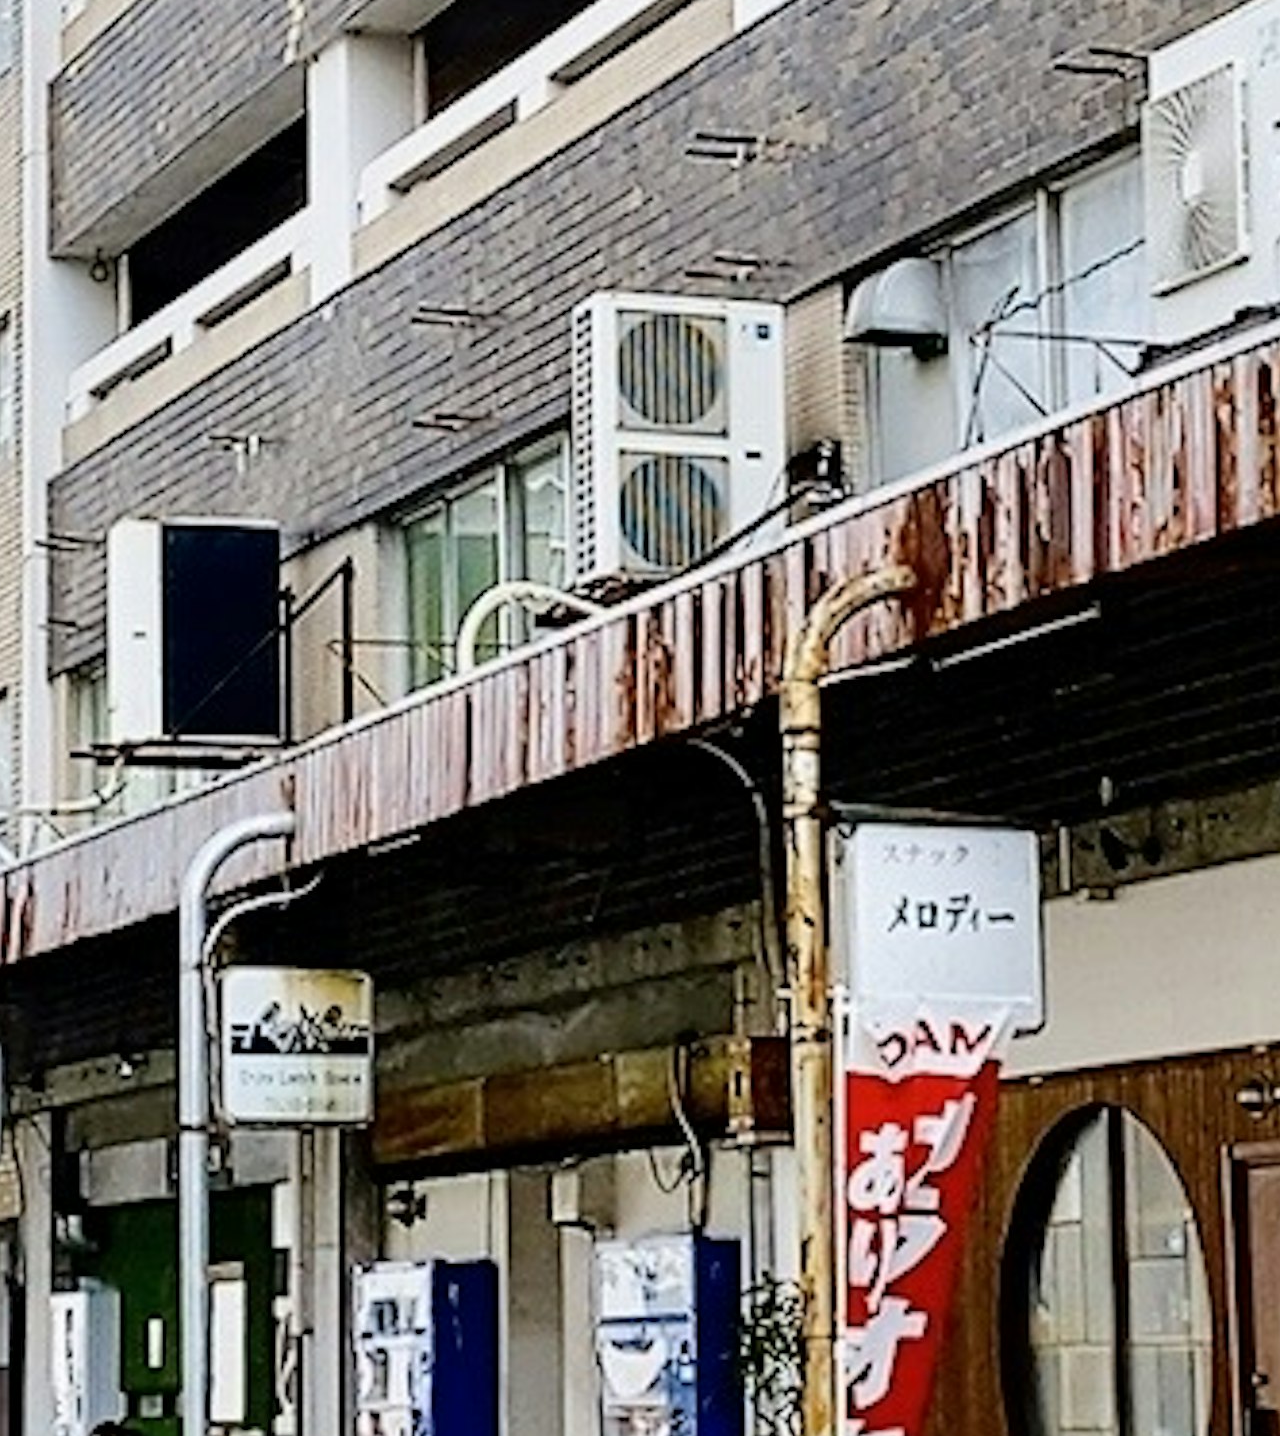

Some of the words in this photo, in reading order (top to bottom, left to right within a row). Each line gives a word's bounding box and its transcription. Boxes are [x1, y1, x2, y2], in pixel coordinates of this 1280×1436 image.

[887, 893, 1015, 933] メロディー
